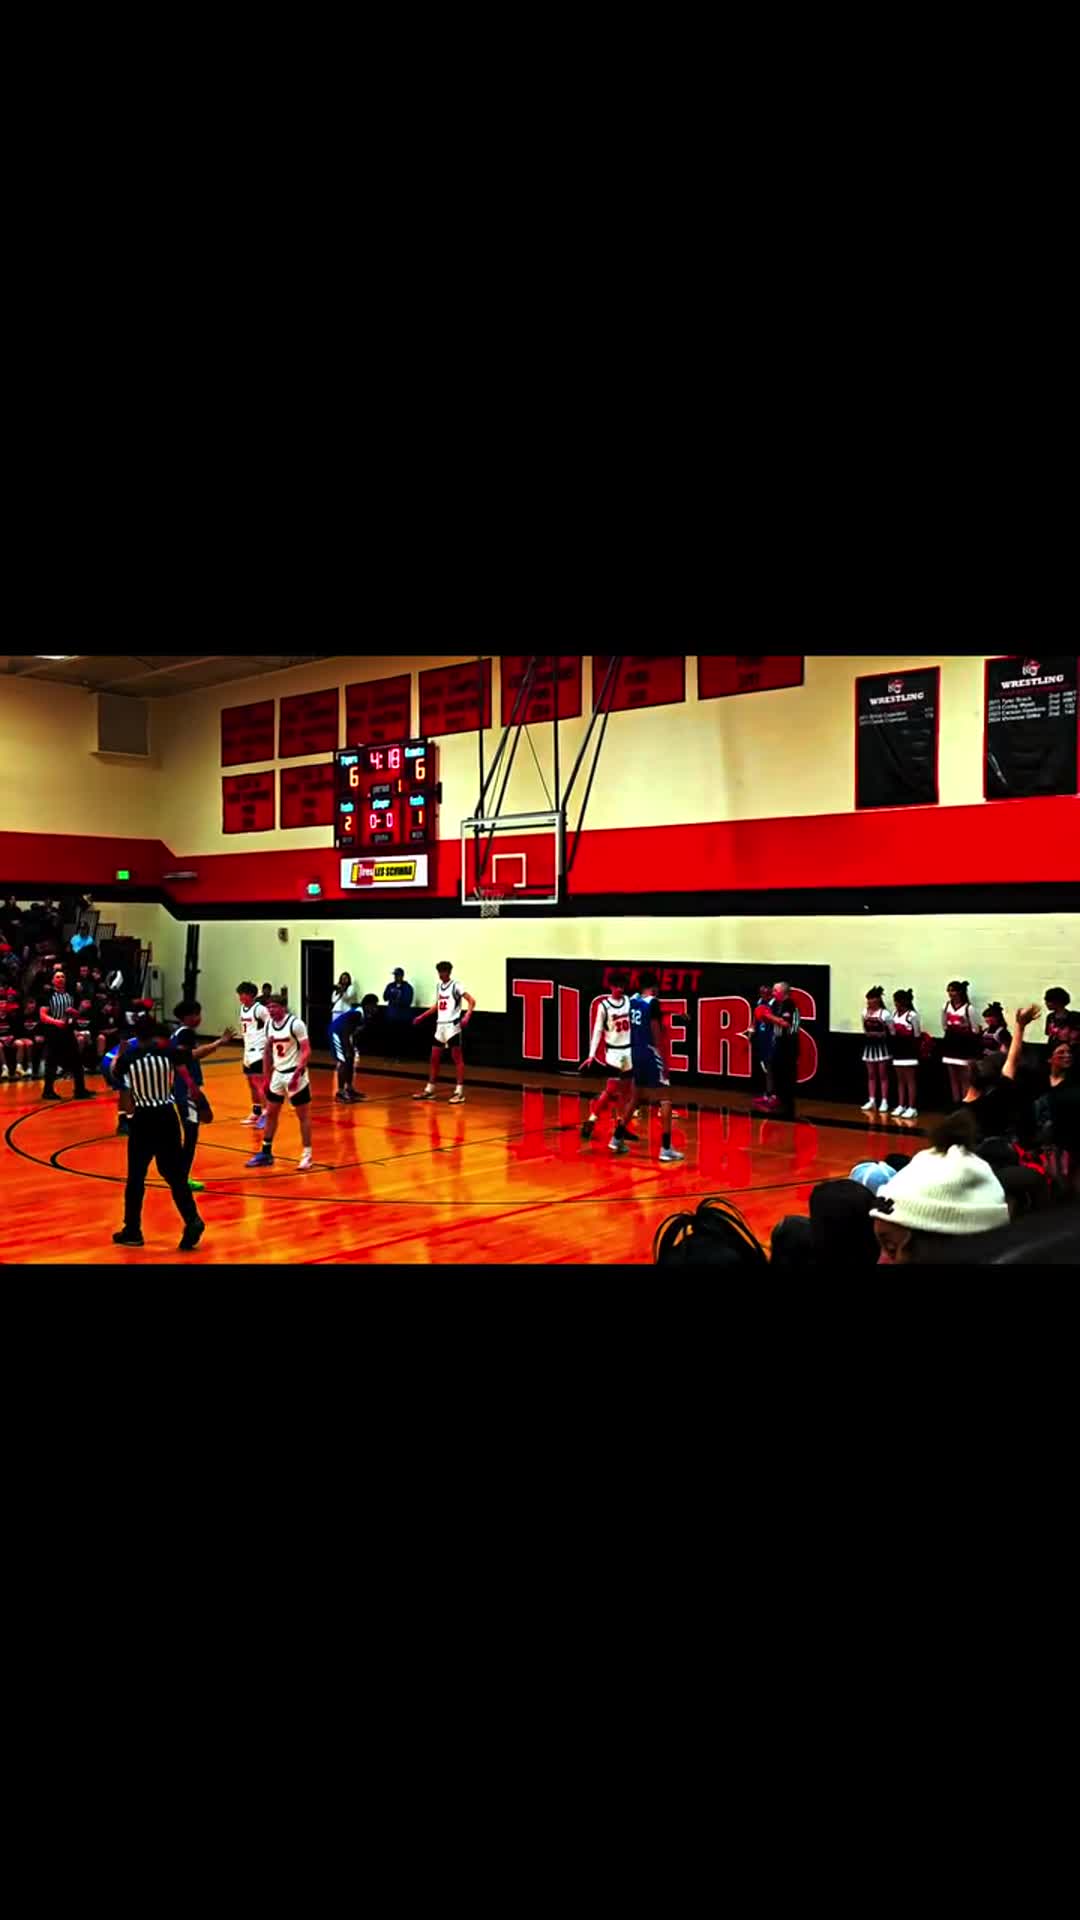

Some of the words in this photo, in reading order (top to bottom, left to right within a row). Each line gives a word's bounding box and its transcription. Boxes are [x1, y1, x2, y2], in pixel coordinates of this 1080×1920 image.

[1000, 674, 1064, 689] WRESTLING
[868, 691, 925, 706] WRESTLING
[370, 748, 400, 770] 4:18
[349, 766, 359, 787] 6
[415, 758, 425, 780] 6
[398, 779, 402, 793] 1
[344, 816, 352, 831] 2
[418, 810, 423, 824] 1
[630, 1008, 642, 1026] 32
[276, 1044, 285, 1058] 2
